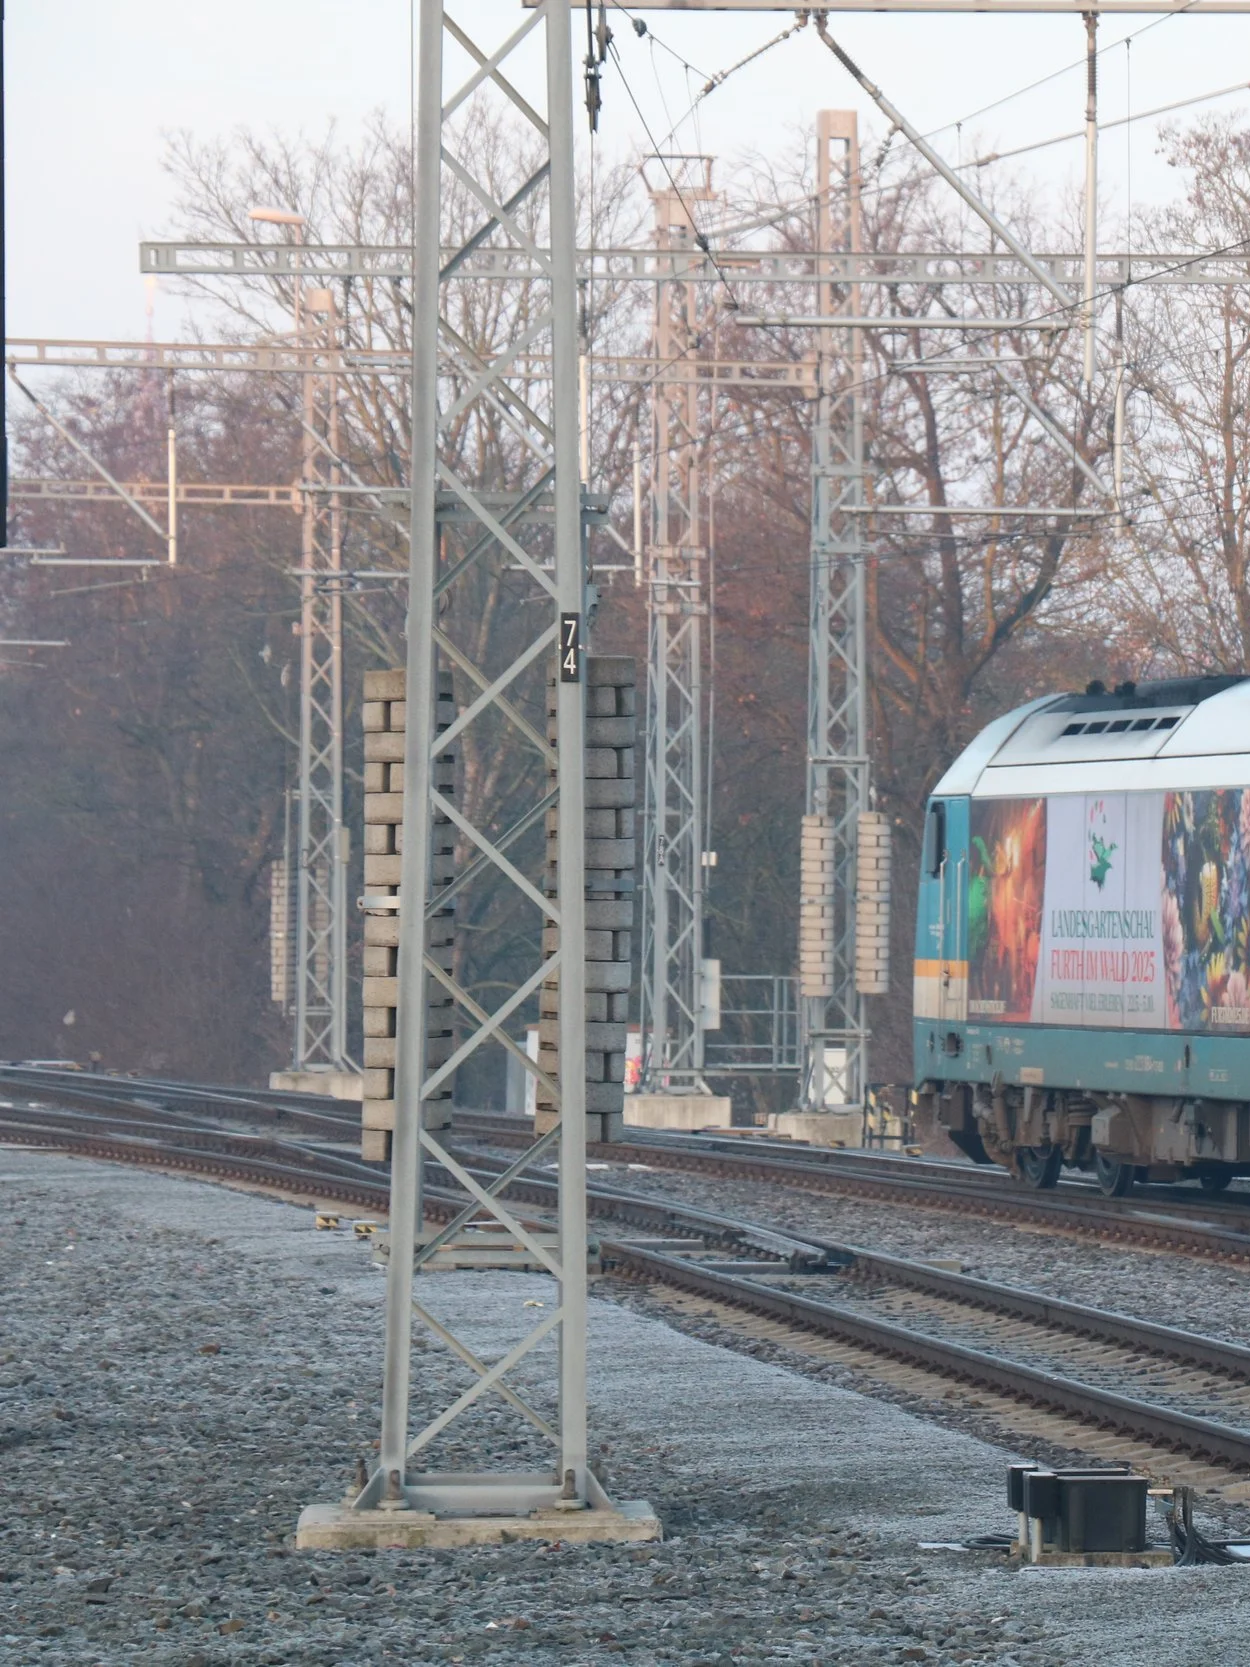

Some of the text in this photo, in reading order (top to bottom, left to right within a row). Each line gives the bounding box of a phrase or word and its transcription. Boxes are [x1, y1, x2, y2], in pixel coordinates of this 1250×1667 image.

[563, 620, 577, 675] 74
[1051, 909, 1157, 939] LANDESGARTENSCHAU
[1050, 948, 1156, 983] FURTH IM WALD 2025
